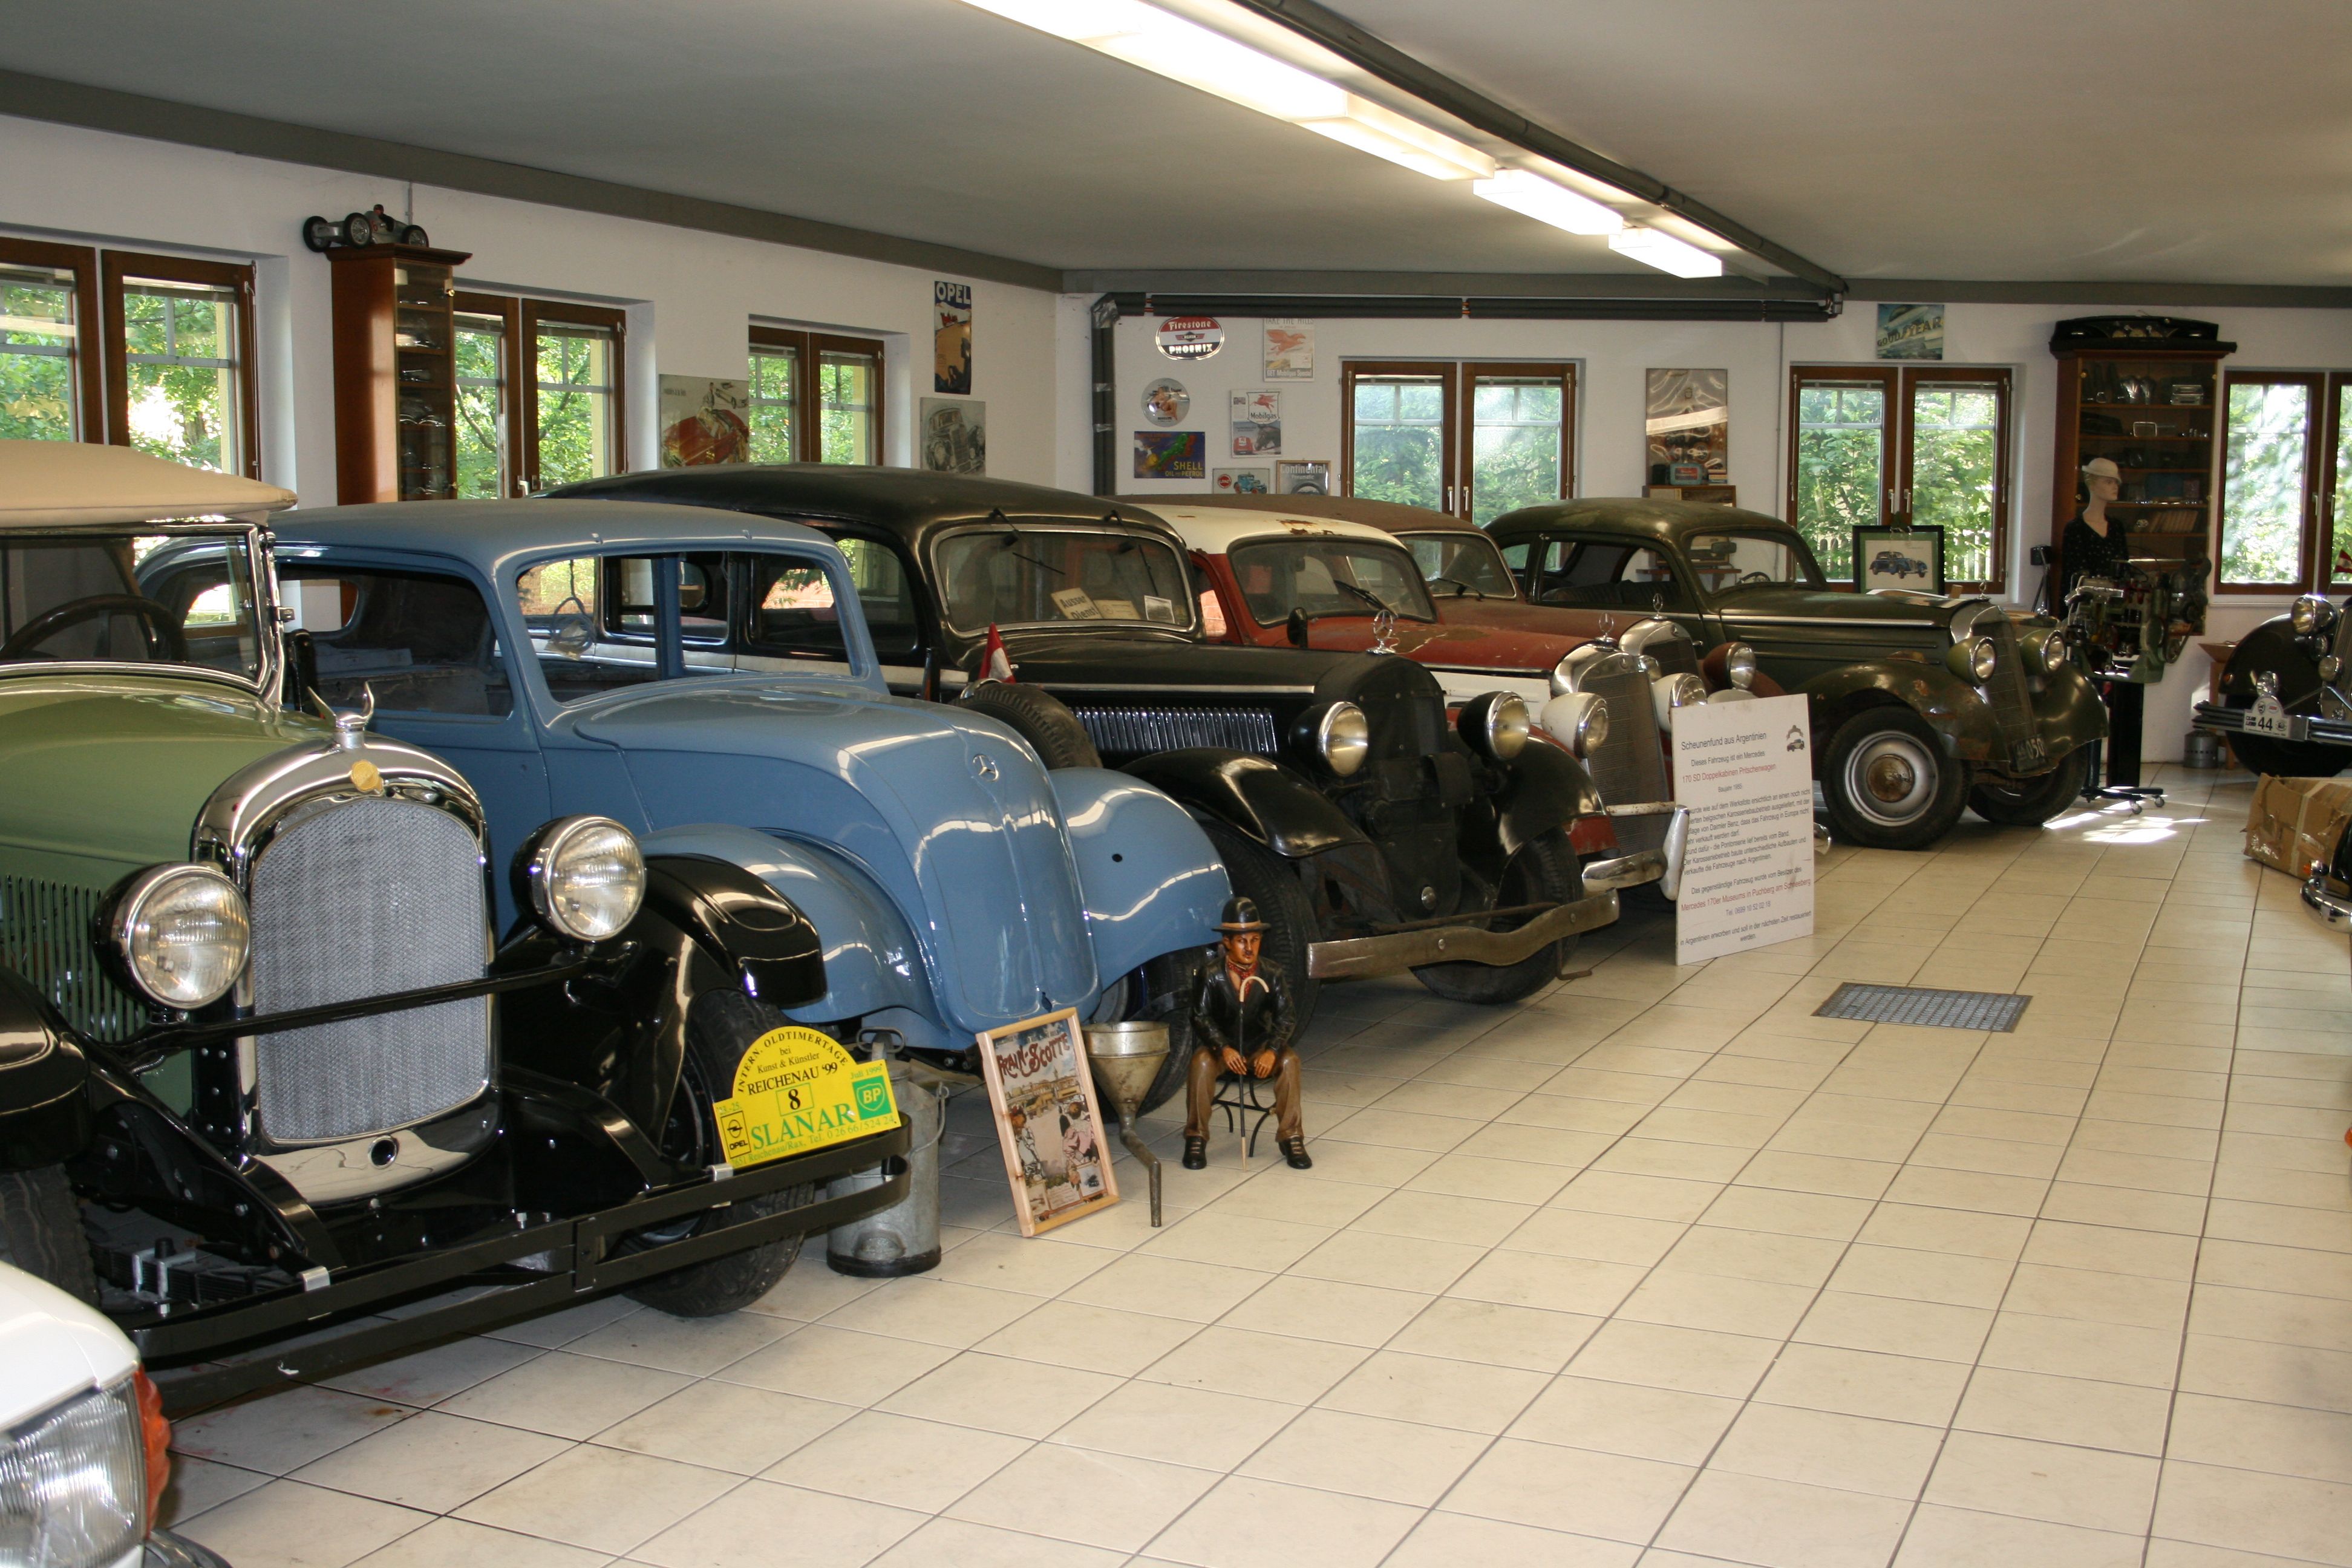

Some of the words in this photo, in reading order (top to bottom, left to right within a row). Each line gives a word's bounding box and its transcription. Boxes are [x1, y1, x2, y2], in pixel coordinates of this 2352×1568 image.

[936, 282, 970, 304] OPEL
[1168, 321, 1211, 331] Firestone
[1169, 344, 1213, 354] PHOENIX
[1174, 461, 1203, 470] SHELL
[1281, 464, 1325, 474] Continental
[2258, 717, 2273, 731] 44
[1681, 737, 1722, 750] Scheunenfund
[1736, 731, 1766, 744] Argentinien
[1691, 758, 1707, 766] Dieses
[1708, 756, 1728, 765] Fahrzeug
[1702, 769, 1737, 781] Doppelkabinen
[1739, 764, 1775, 776] Pritschenwagen
[1760, 814, 1779, 823] Fahrzeug
[1713, 860, 1735, 871] Fahrzeuge
[1733, 877, 1753, 886] Fahrzeug
[1681, 900, 1705, 910] Mercedes
[1707, 897, 1721, 906] 170er
[1722, 892, 1745, 903] Museums
[1752, 886, 1774, 897] Puchberg
[1685, 934, 1710, 946] Argentinien
[779, 1046, 791, 1056] bei
[737, 1048, 763, 1093] INTERN.
[763, 1031, 848, 1066] OLDTIMERTAGE
[757, 1063, 778, 1074] Kunst
[779, 1059, 786, 1068] &
[788, 1053, 820, 1066] Künstler
[747, 1066, 819, 1096] REICHENAU
[788, 1089, 801, 1109] 8
[863, 1088, 881, 1104] BP
[751, 1103, 855, 1150] SLANAR
[836, 1128, 846, 1137] 26
[729, 1140, 748, 1150] OPEL
